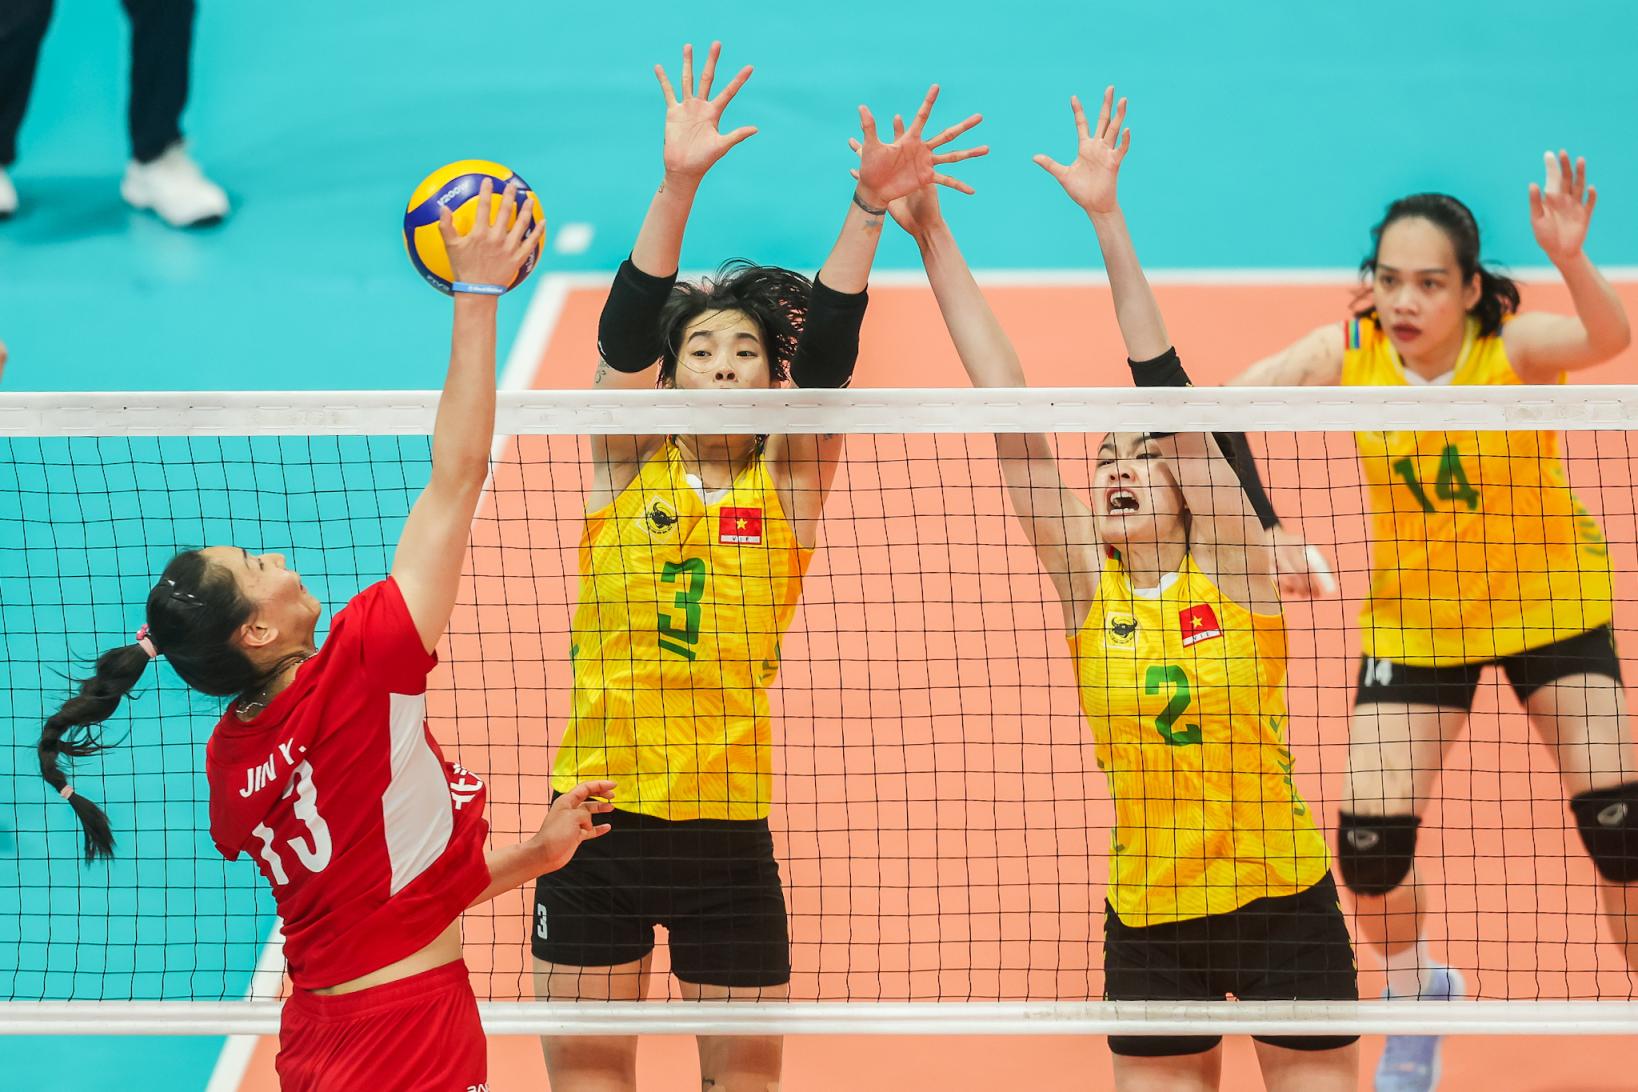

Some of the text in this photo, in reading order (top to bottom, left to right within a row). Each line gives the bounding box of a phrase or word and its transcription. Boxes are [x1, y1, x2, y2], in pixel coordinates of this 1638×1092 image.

[1393, 444, 1480, 514] 14
[658, 557, 706, 646] 3
[1145, 664, 1203, 747] 2
[239, 738, 307, 798] JIN Y.
[251, 759, 333, 886] 13
[537, 903, 548, 940] 3
